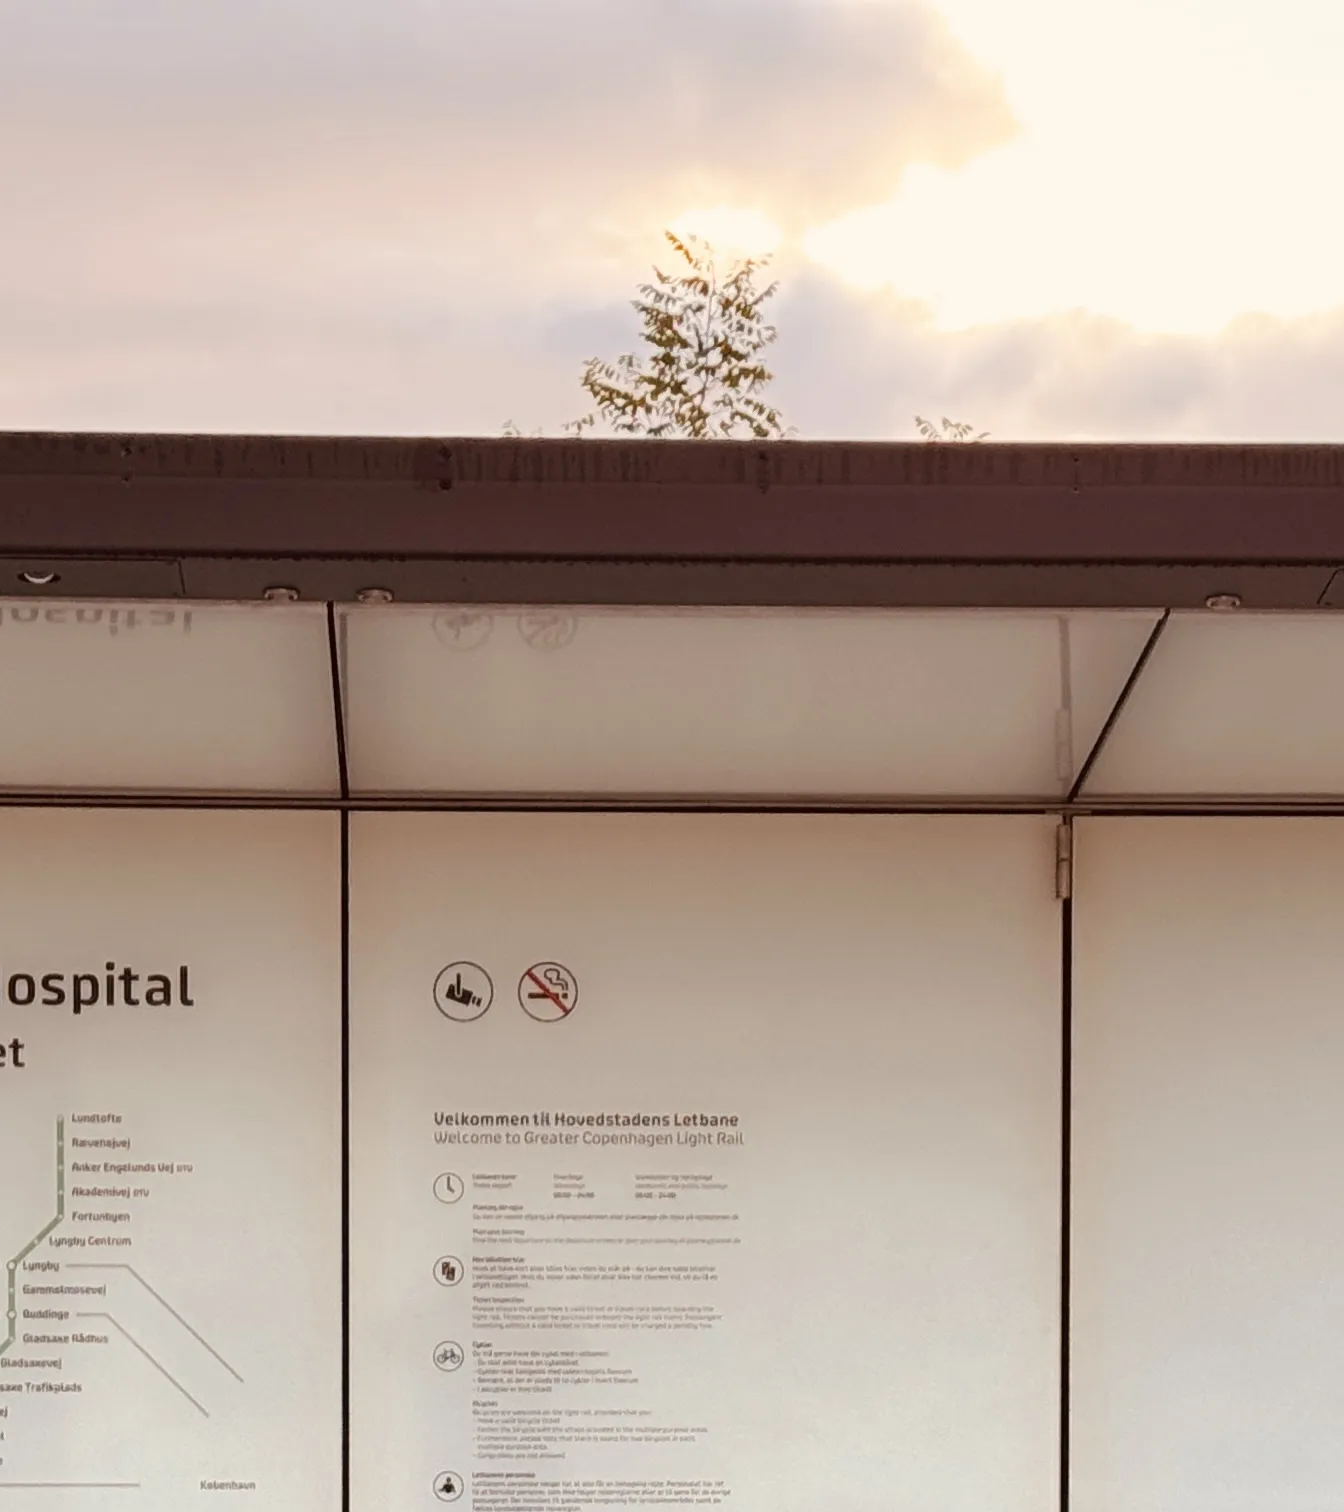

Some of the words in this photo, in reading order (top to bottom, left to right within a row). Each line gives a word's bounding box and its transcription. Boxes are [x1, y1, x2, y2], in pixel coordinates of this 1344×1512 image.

[72, 1113, 122, 1123] Lundtofte
[434, 1112, 529, 1126] Velkommen
[532, 1111, 550, 1126] til
[555, 1113, 670, 1126] Hovedstadens
[674, 1113, 738, 1127] Letbane
[434, 1131, 502, 1144] Welcome
[505, 1132, 520, 1144] to
[524, 1131, 580, 1144] Greater
[583, 1131, 673, 1147] Copenhagen
[677, 1131, 713, 1147] Light
[717, 1131, 743, 1145] Rail
[72, 1162, 101, 1172] Anker
[104, 1162, 156, 1174] Engelunds
[158, 1162, 174, 1174] Vej
[72, 1187, 130, 1199] Akademivej
[72, 1211, 130, 1223] Fortunbyen
[47, 1234, 86, 1248] Lyngby
[88, 1236, 132, 1246] Centrum
[21, 1259, 60, 1272] Lyngby
[23, 1309, 69, 1320] Buddinge
[23, 1333, 69, 1343] Gladsaxe
[72, 1333, 108, 1343] Rådhus
[25, 1382, 82, 1394] Trafikplads
